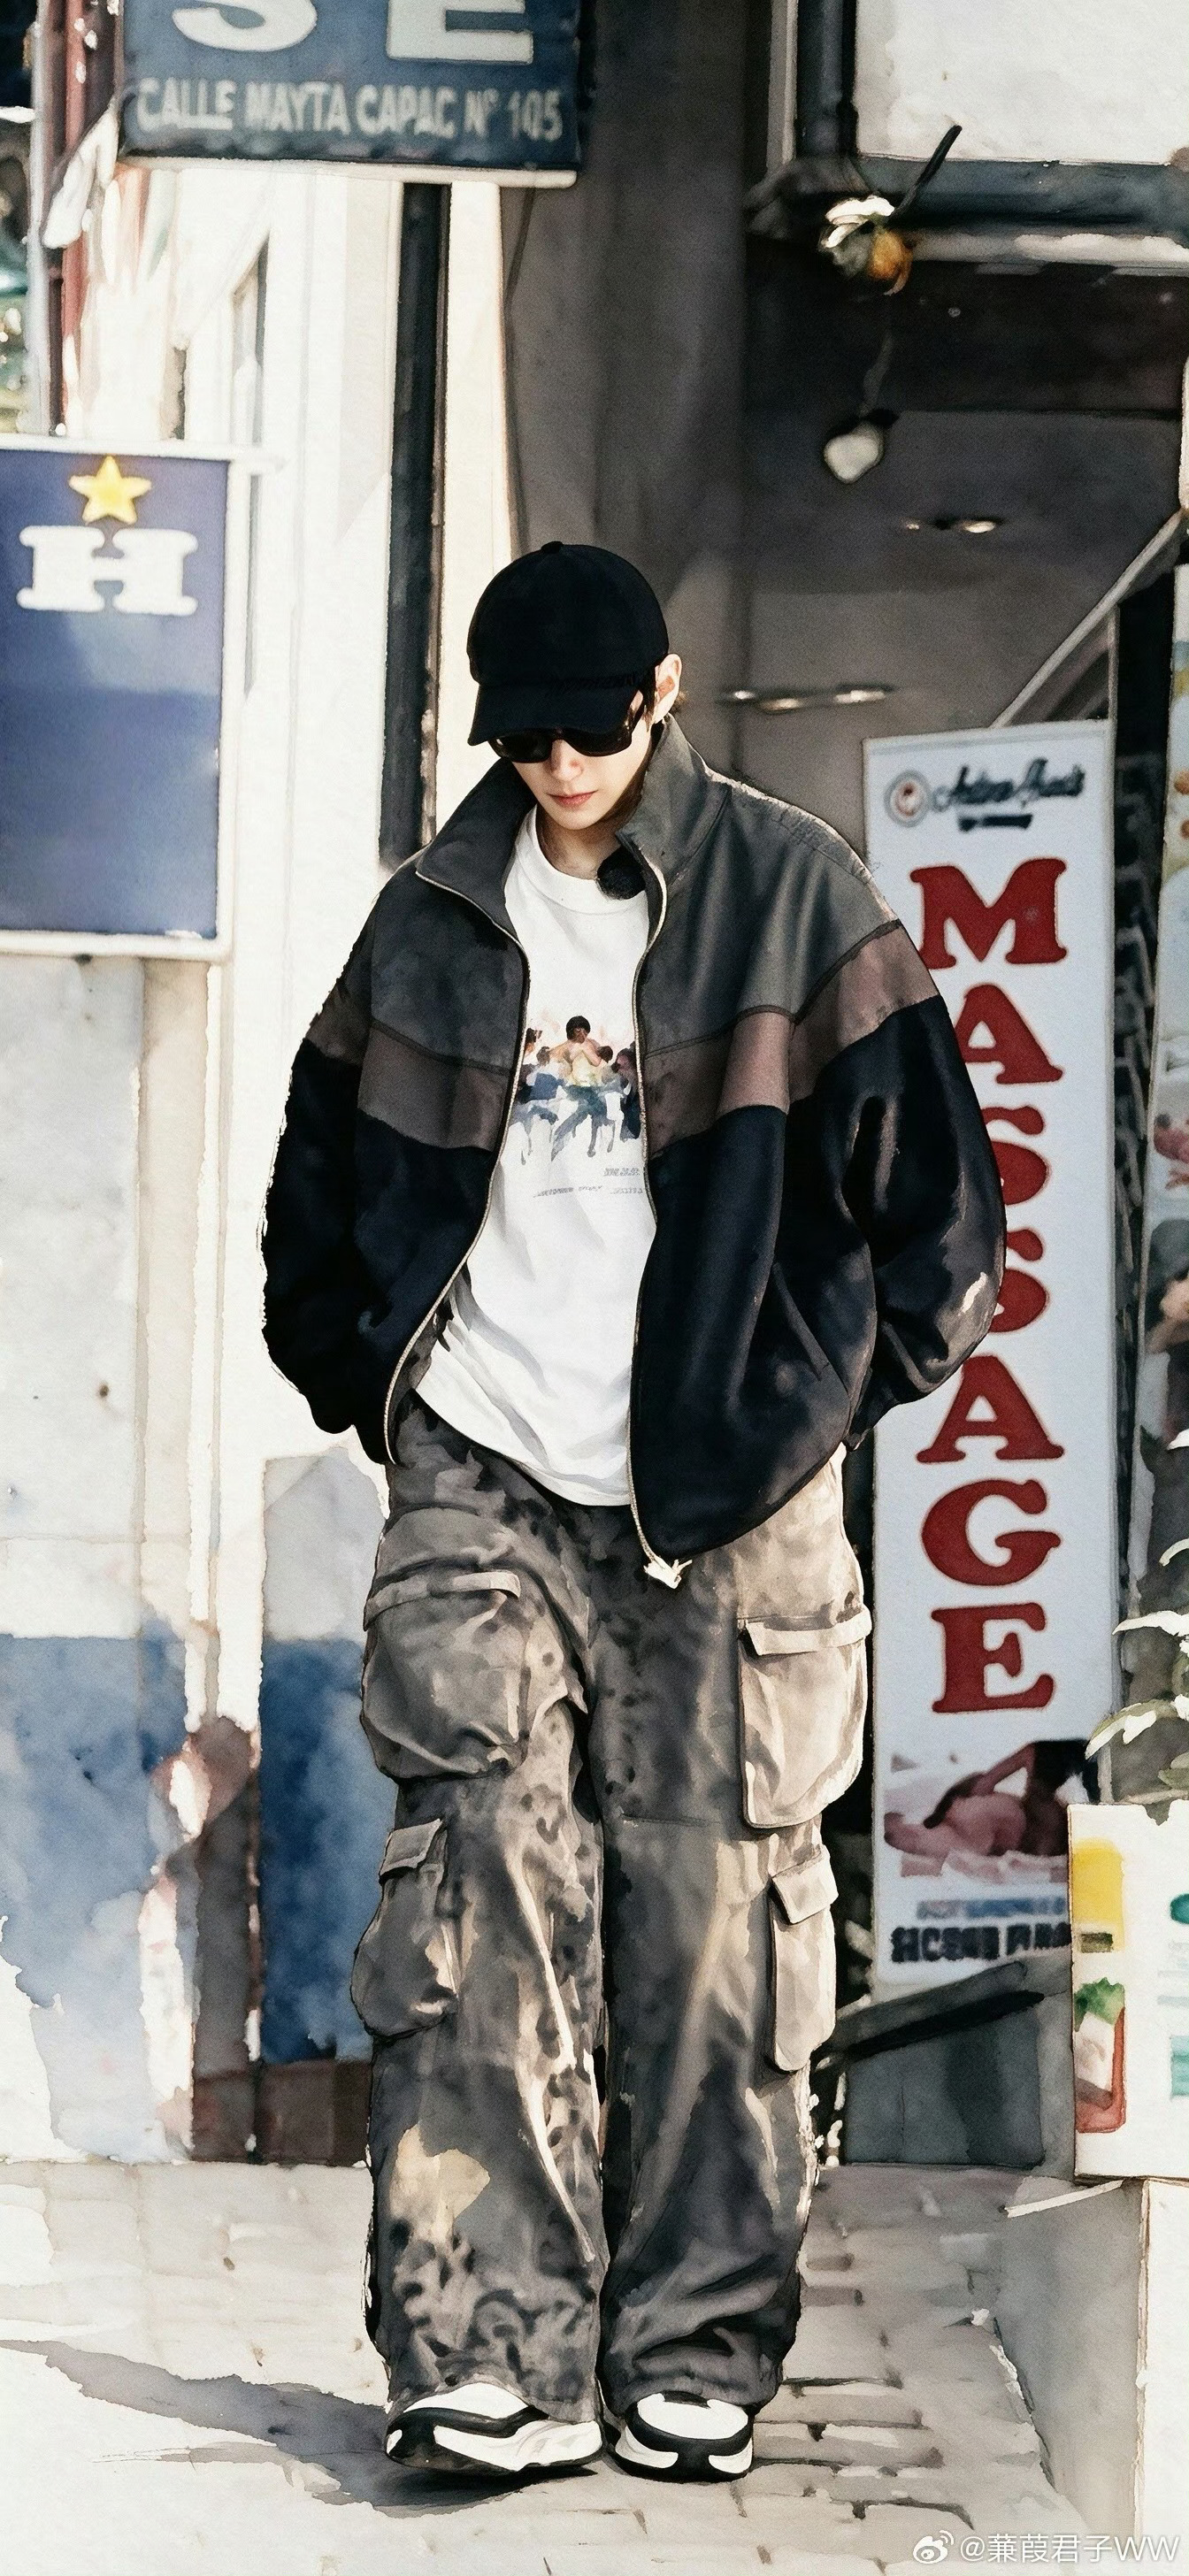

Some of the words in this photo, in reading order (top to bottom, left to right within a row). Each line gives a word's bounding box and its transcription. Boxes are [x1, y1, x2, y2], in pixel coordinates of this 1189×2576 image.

[136, 77, 237, 131] CALLE
[245, 80, 351, 134] MAYTA
[356, 84, 456, 138] CAPAC
[508, 89, 564, 142] 105
[16, 525, 198, 615] H
